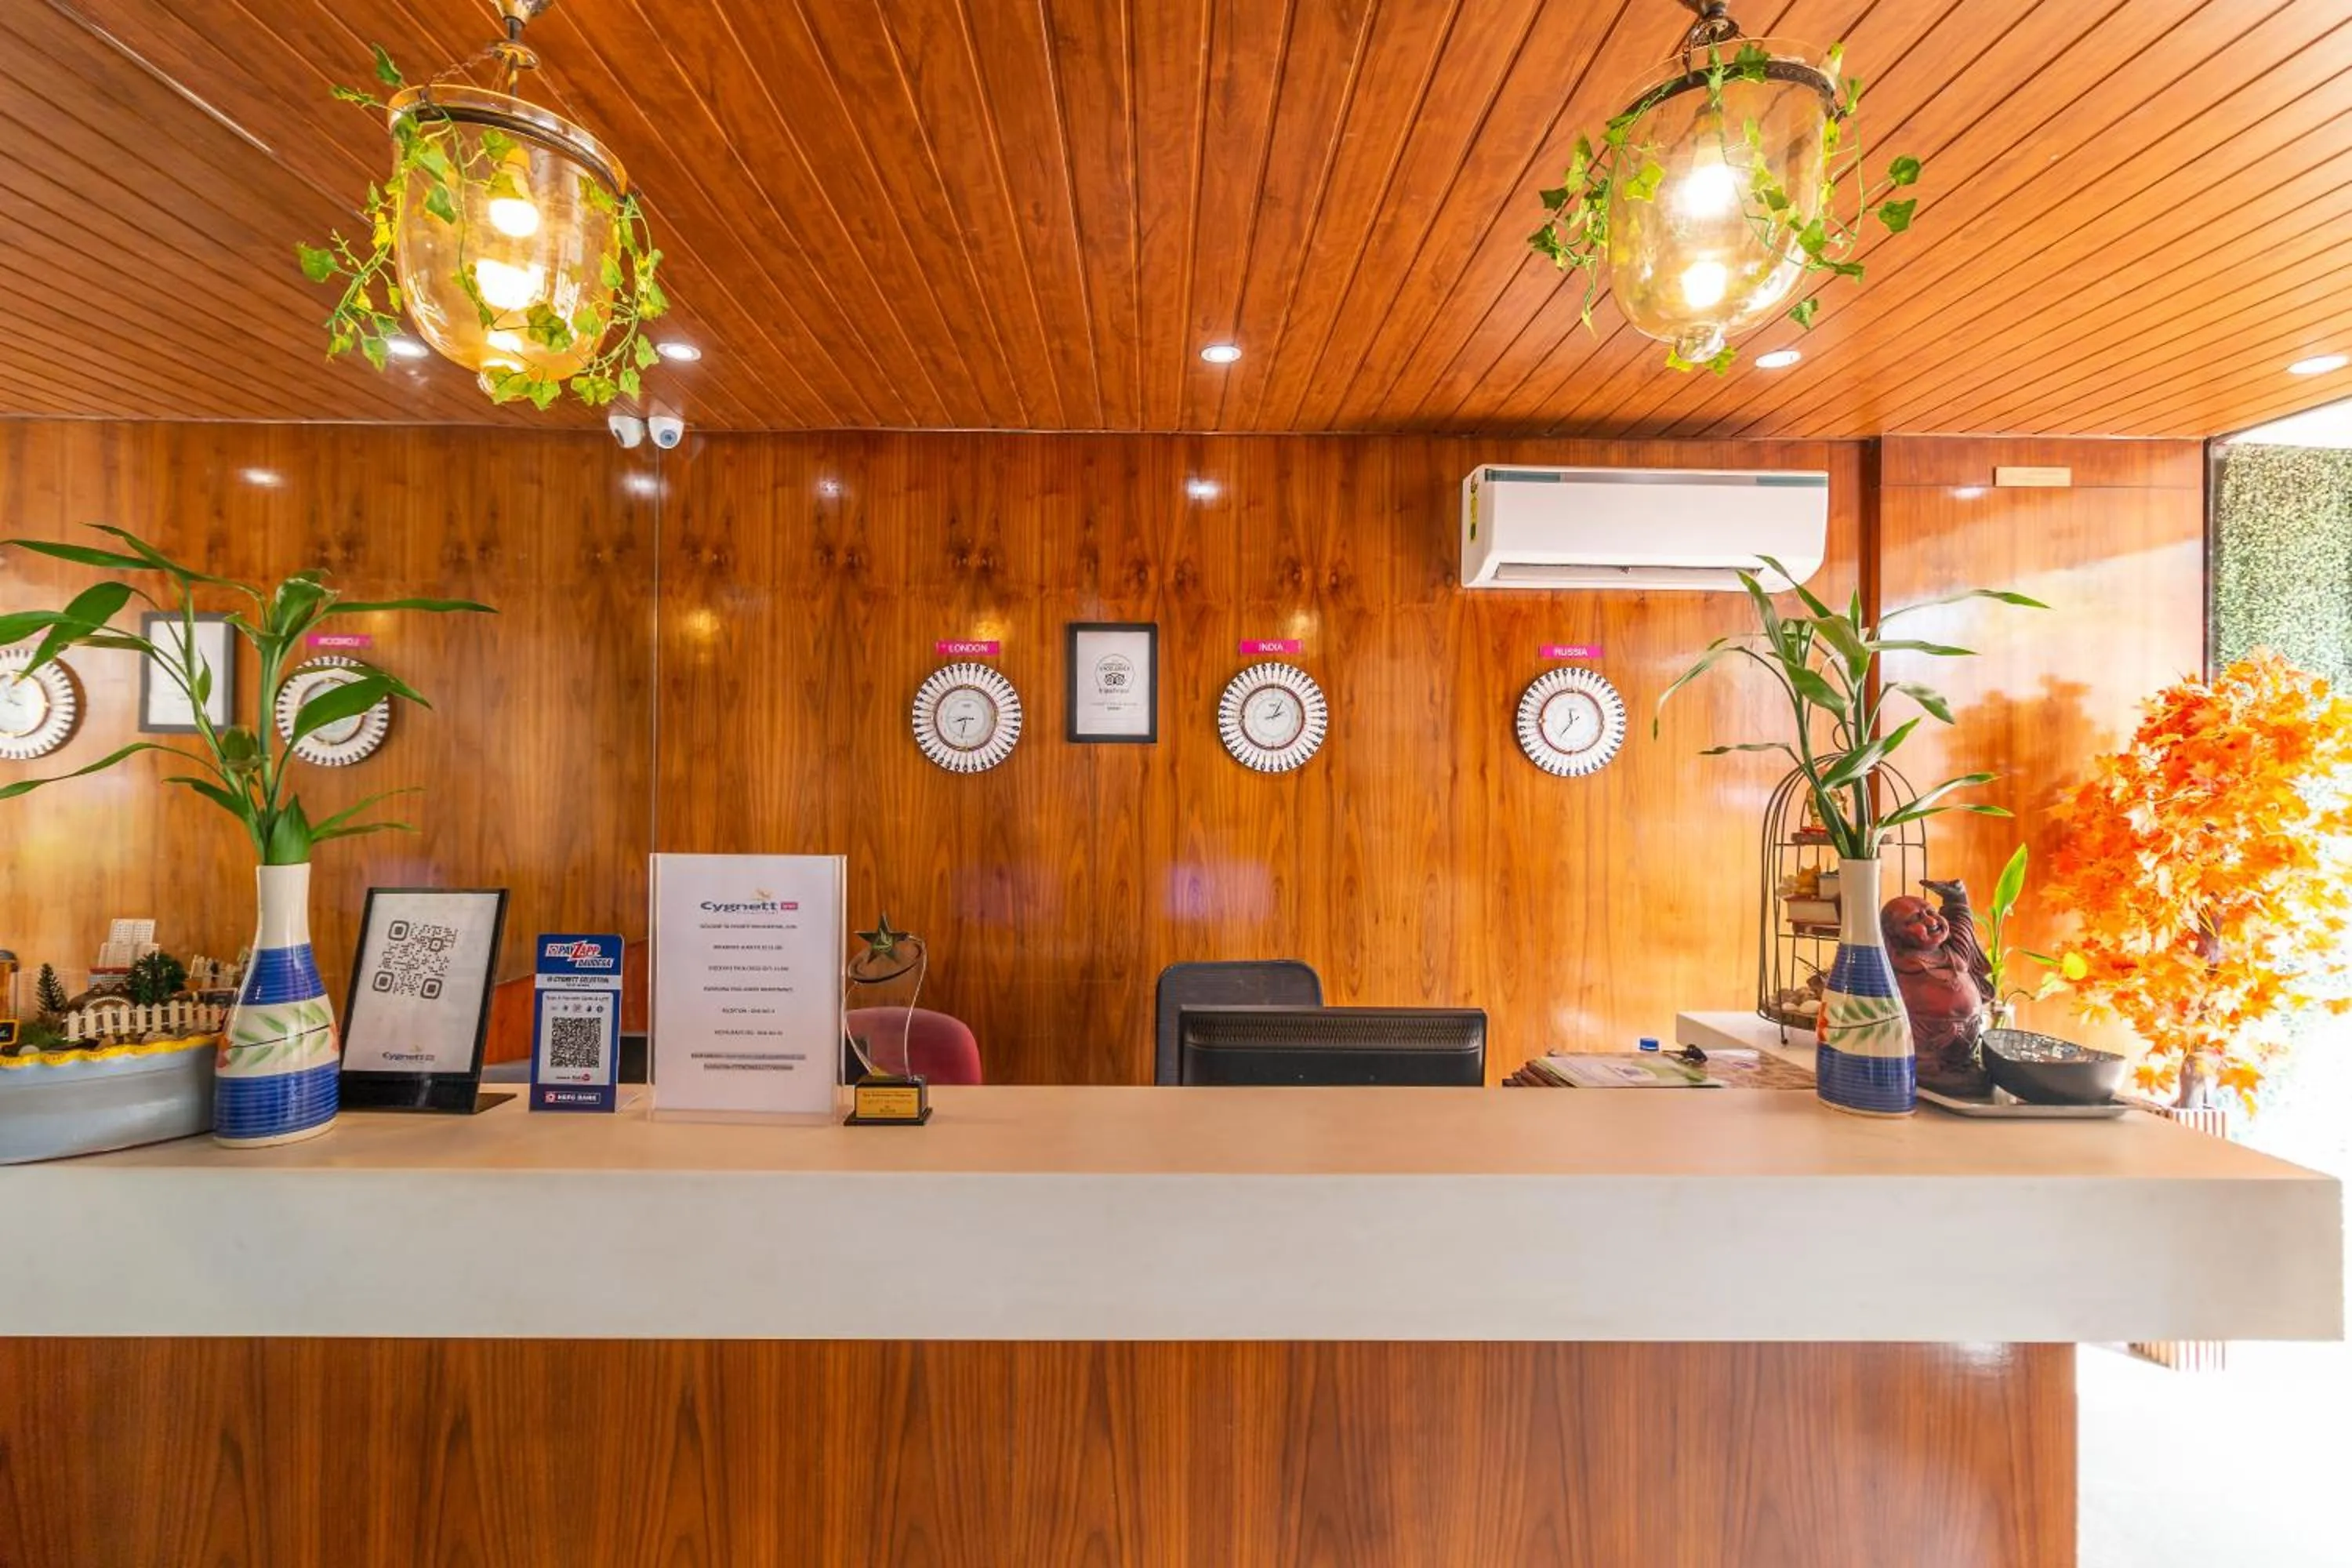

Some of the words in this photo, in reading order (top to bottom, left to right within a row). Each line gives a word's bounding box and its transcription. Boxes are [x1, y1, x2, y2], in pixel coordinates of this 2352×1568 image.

[948, 644, 988, 653] LONDON
[1258, 643, 1283, 652] INDIA
[1553, 647, 1588, 656] RUSSIA
[700, 901, 777, 912] Cygnett
